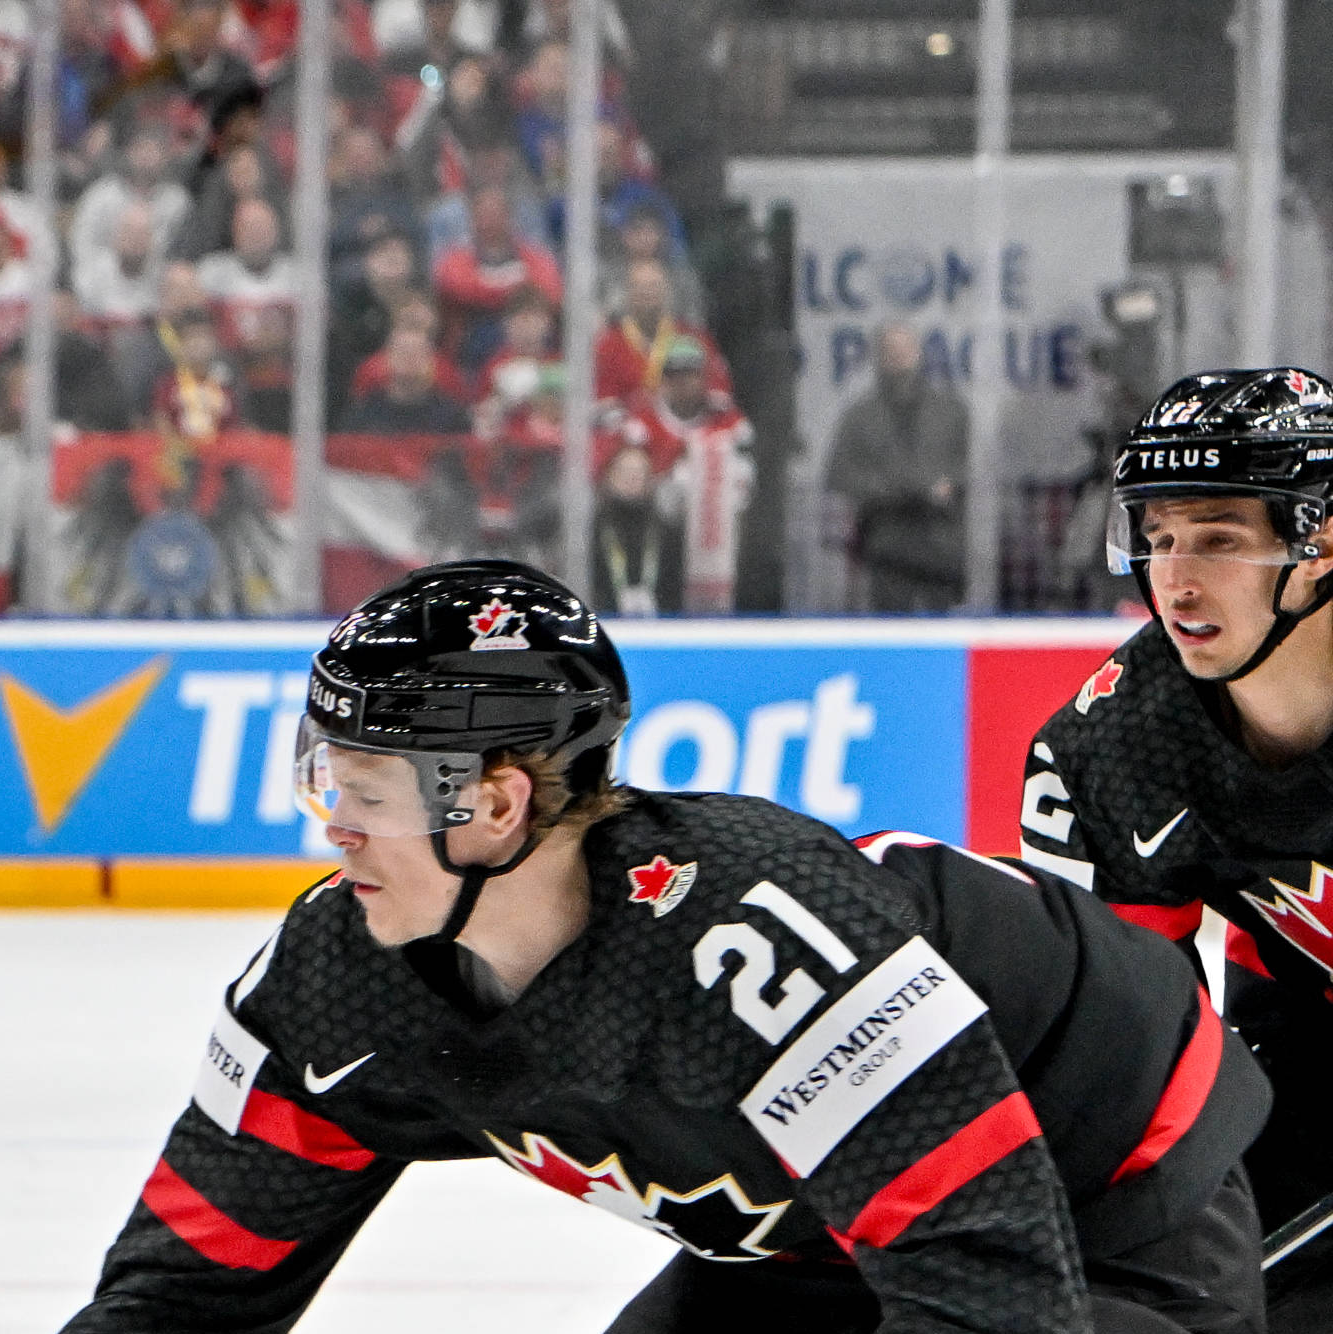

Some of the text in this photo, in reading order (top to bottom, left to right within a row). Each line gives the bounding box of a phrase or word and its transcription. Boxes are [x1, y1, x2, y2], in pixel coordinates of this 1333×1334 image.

[1139, 448, 1221, 471] TELUS
[692, 880, 860, 1047] 21
[761, 966, 947, 1129] WESTMINSTER
[847, 1035, 904, 1088] GROUP
